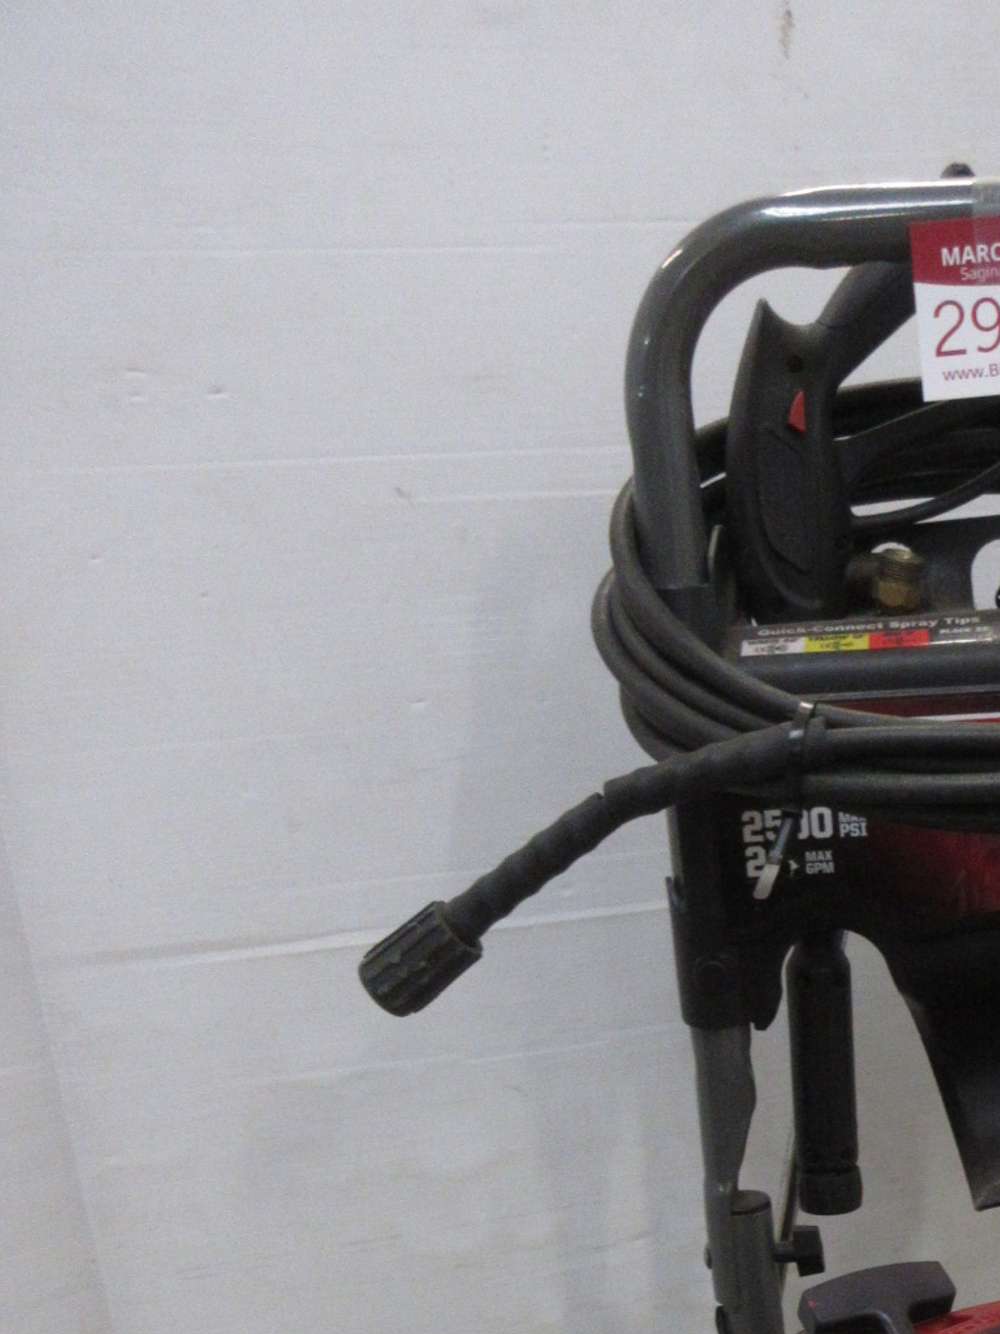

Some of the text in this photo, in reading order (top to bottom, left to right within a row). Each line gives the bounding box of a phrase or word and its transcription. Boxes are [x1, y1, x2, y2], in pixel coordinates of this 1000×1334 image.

[889, 618, 938, 630] Spray
[944, 615, 980, 626] Tips
[839, 822, 868, 838] PSI
[805, 850, 833, 862] MAX
[805, 862, 835, 875] GPM
